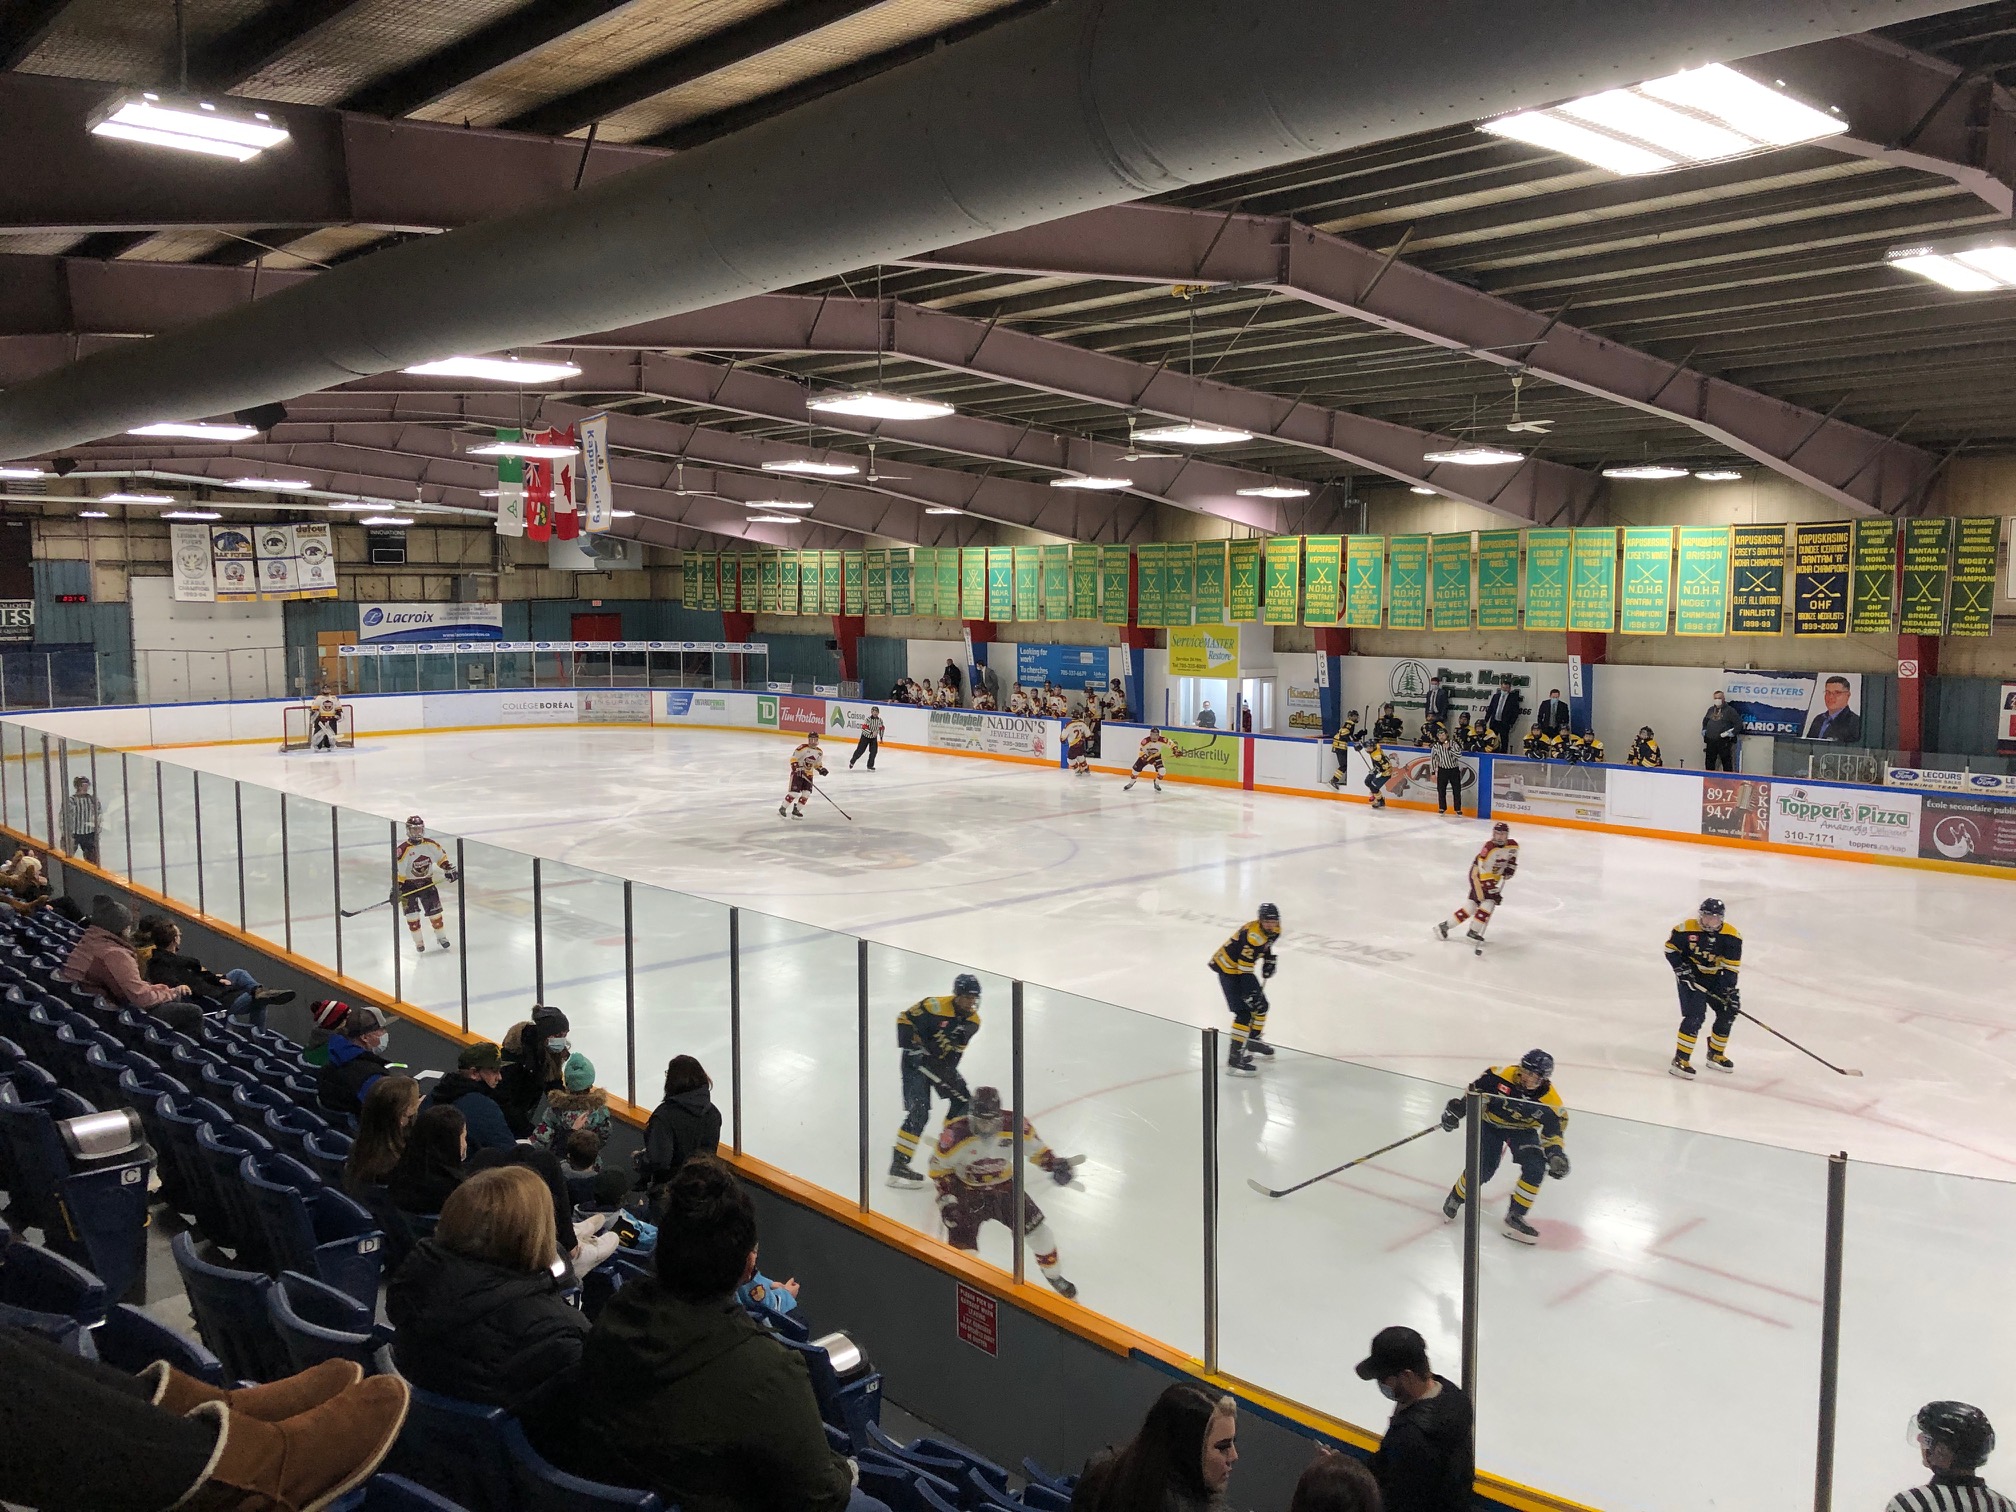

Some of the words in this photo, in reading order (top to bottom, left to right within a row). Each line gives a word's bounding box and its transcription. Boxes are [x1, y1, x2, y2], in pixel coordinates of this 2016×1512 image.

[587, 430, 602, 523] Kapuskasing
[1735, 535, 1783, 545] KAPUSKASING
[1799, 533, 1848, 545] KAPUSKASING
[1309, 556, 1336, 564] KAPITALS
[1686, 551, 1722, 559] BRISSON
[1802, 556, 1832, 564] BANTAM
[1734, 559, 1751, 567] NOHA
[1751, 559, 1784, 567] CHAMPIONS
[1797, 565, 1813, 573] NOHA
[1814, 564, 1848, 573] CHAMPIONS
[1681, 599, 1710, 607] MIDGET
[1749, 596, 1758, 605] ALL
[1810, 600, 1832, 610] OHF
[386, 611, 434, 624] Lacroix
[1682, 611, 1720, 619] CHAMPIONS
[1739, 609, 1776, 617] FINALISTS
[1802, 622, 1838, 630] 1999-2000
[1020, 648, 1039, 656] Looking
[1208, 650, 1232, 661] Restore
[1027, 666, 1048, 674] cherches
[1437, 667, 1473, 684] First
[1478, 669, 1531, 688] Nation
[1727, 685, 1751, 694] LET'S
[1753, 686, 1768, 694] GO
[1770, 687, 1804, 696] FLYERS
[760, 701, 776, 720] TD
[781, 707, 794, 721] Tim
[794, 709, 824, 725] Hortons
[847, 710, 865, 720] Caisse
[930, 711, 950, 724] North
[951, 713, 983, 727] Claybelt
[987, 716, 1045, 734] NADON'S
[1743, 722, 1775, 731] TARIO
[1778, 724, 1792, 733] PC
[990, 730, 1029, 740] JEWELLERY
[1181, 746, 1230, 765] bakertilly
[1922, 771, 1962, 780] LECOURS
[1757, 784, 1769, 831] CKGN
[1778, 797, 1853, 821] Topper's
[1857, 805, 1909, 826] Pizza
[1926, 799, 1948, 810] École
[1949, 803, 1992, 813] secondaire
[1706, 805, 1733, 820] 94,7
[1820, 820, 1868, 836] Amazingly
[1784, 830, 1834, 844] 310-7171
[1848, 840, 1906, 853] toppers.ca/kap
[125, 1169, 137, 1183] C
[365, 1240, 375, 1252] D
[976, 1297, 987, 1307] PICK
